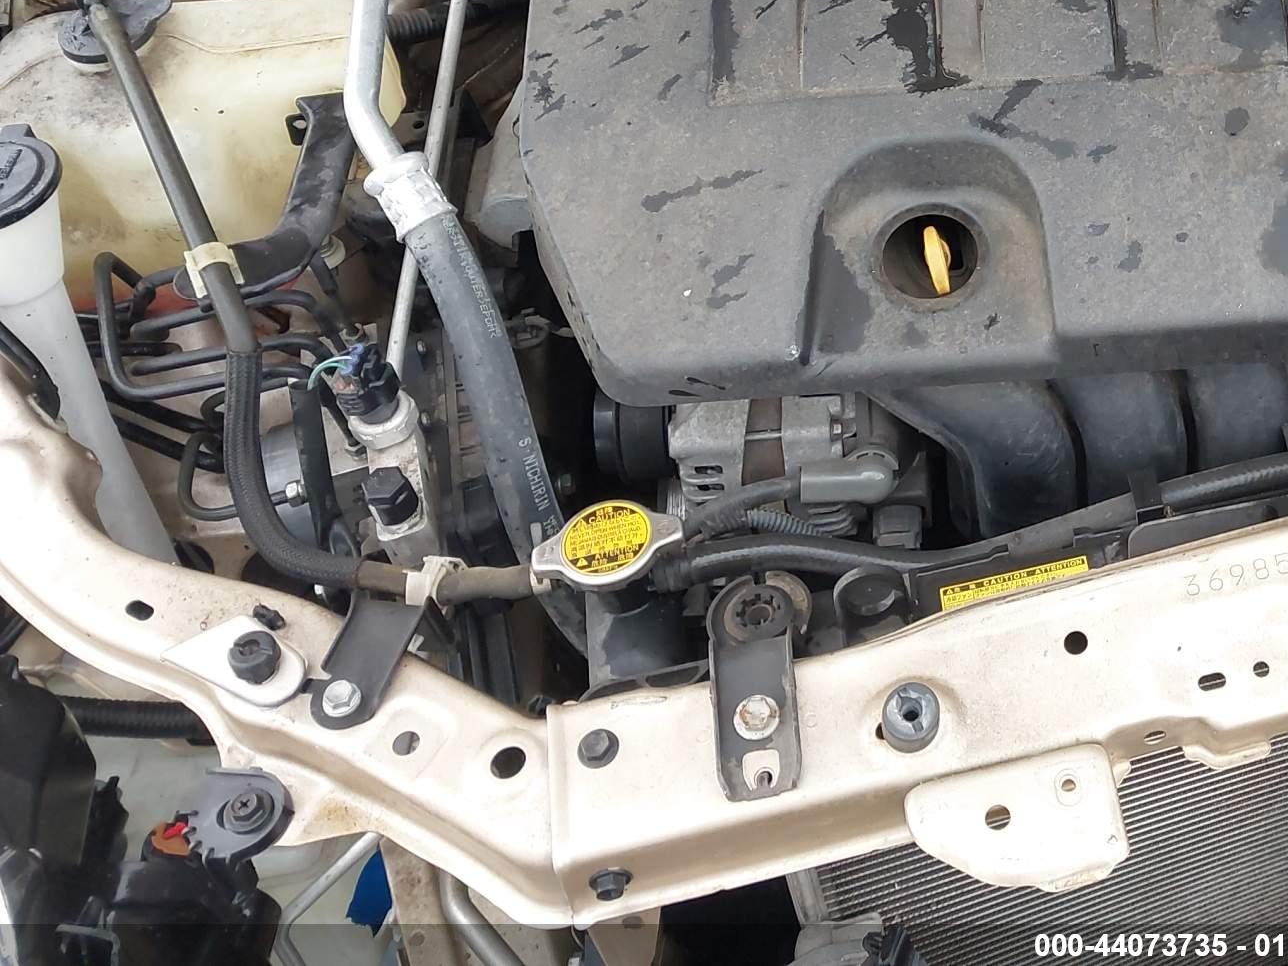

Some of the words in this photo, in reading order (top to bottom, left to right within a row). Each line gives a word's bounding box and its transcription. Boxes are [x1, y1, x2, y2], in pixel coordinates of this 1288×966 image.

[522, 454, 552, 512] NICHIRIN
[588, 509, 631, 524] CAUTION
[595, 545, 639, 560] ATTENTION
[983, 571, 1028, 586] CAUTION
[1035, 558, 1083, 574] ATTENTION
